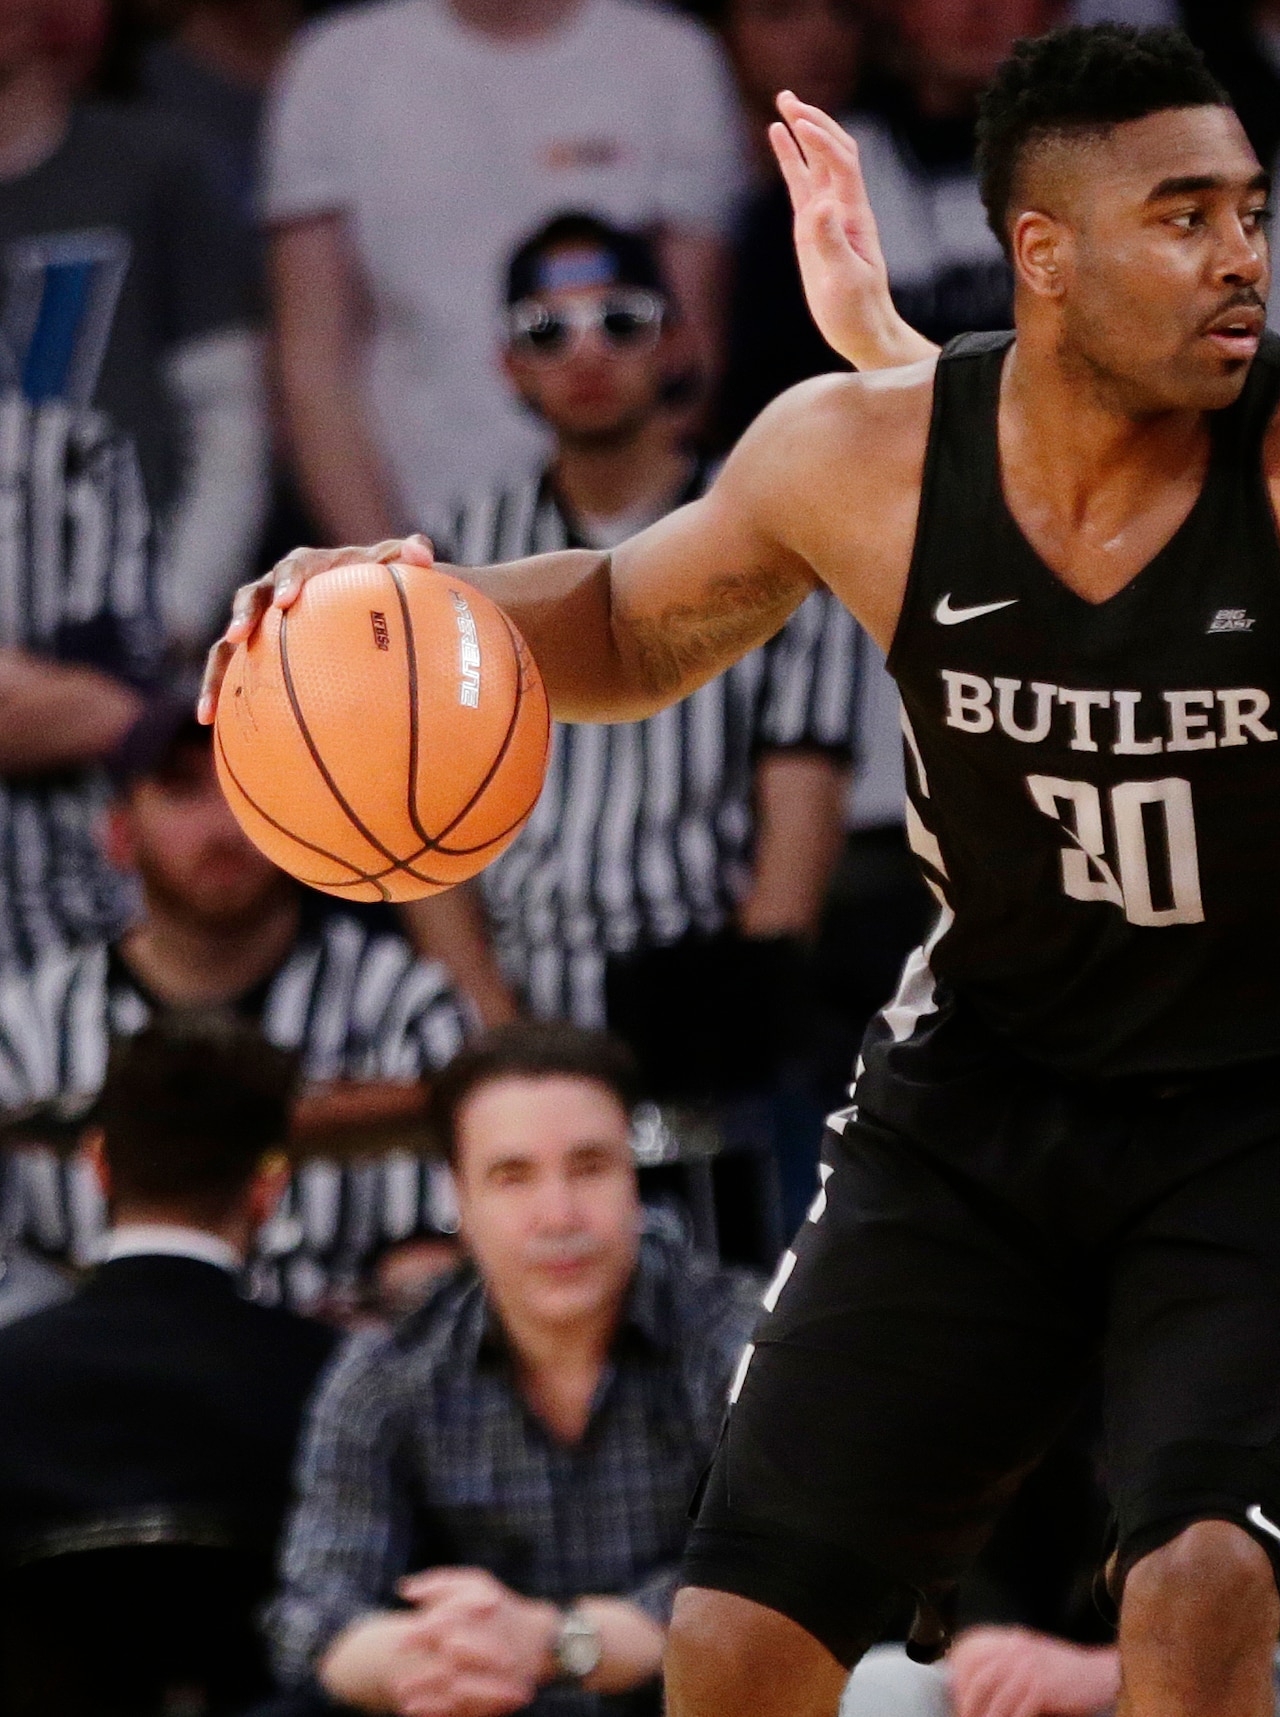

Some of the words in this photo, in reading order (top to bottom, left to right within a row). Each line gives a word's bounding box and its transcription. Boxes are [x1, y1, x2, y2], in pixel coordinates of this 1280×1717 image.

[1215, 609, 1247, 620] BIG
[1209, 619, 1256, 630] EAST
[941, 668, 1279, 756] BUTLER
